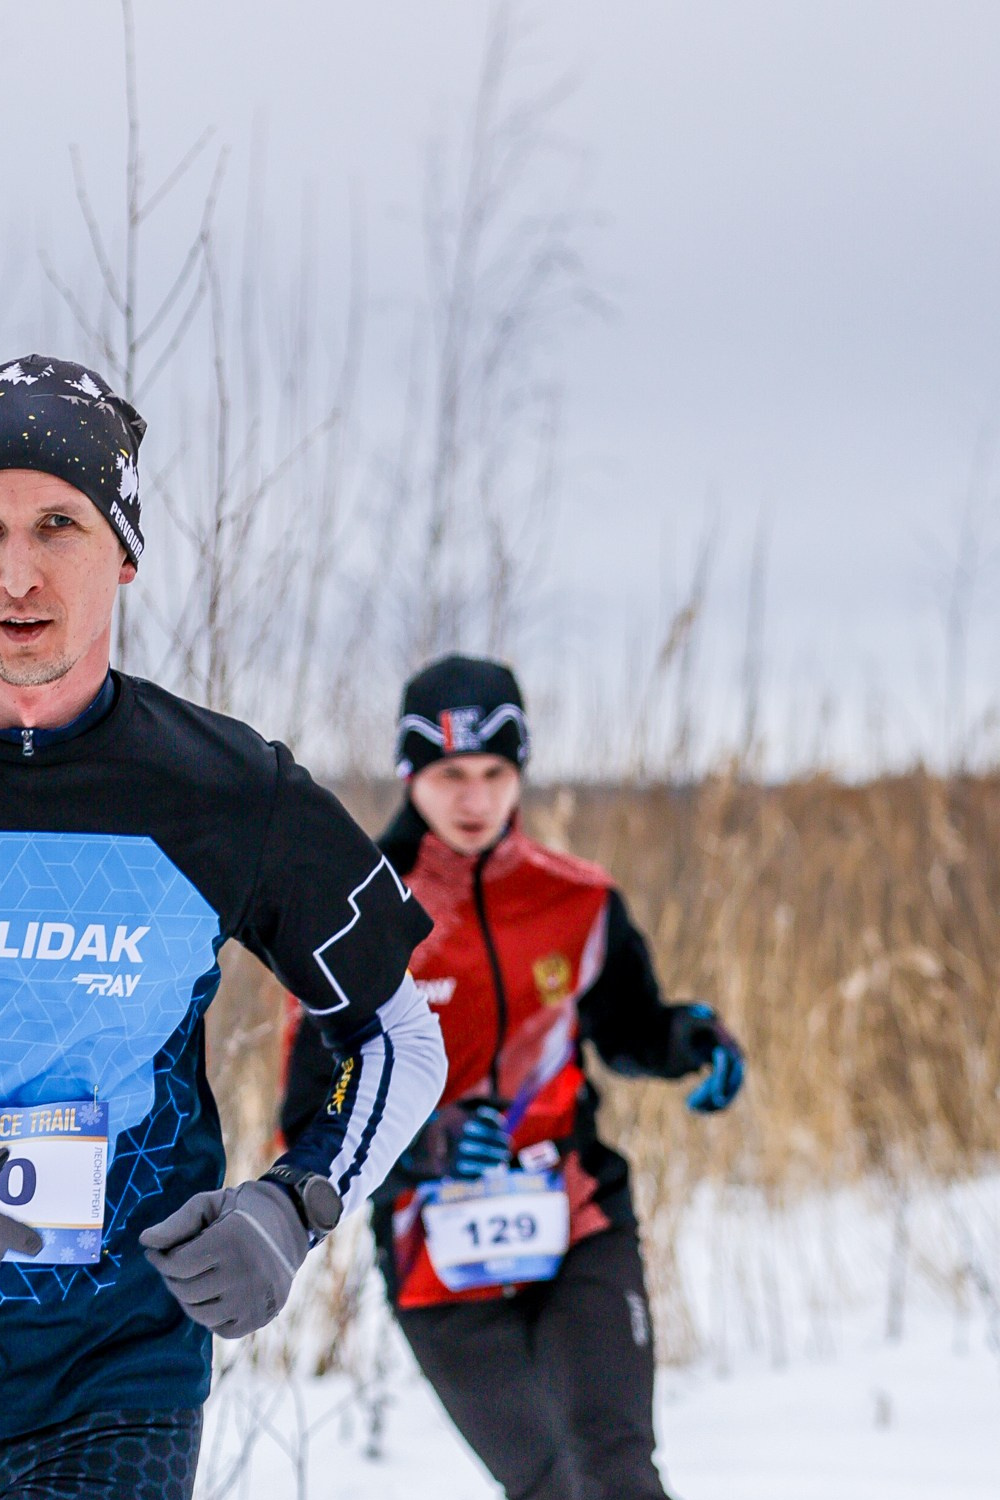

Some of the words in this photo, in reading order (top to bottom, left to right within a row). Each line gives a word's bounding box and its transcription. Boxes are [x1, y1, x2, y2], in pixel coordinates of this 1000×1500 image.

[110, 501, 144, 560] PERVOUR
[73, 973, 142, 998] RAY
[30, 1108, 82, 1134] TRAIL
[93, 1146, 103, 1186] ЛЕСНОЙ
[91, 1187, 102, 1218] ТРЕЙЛ
[464, 1213, 537, 1247] 129
